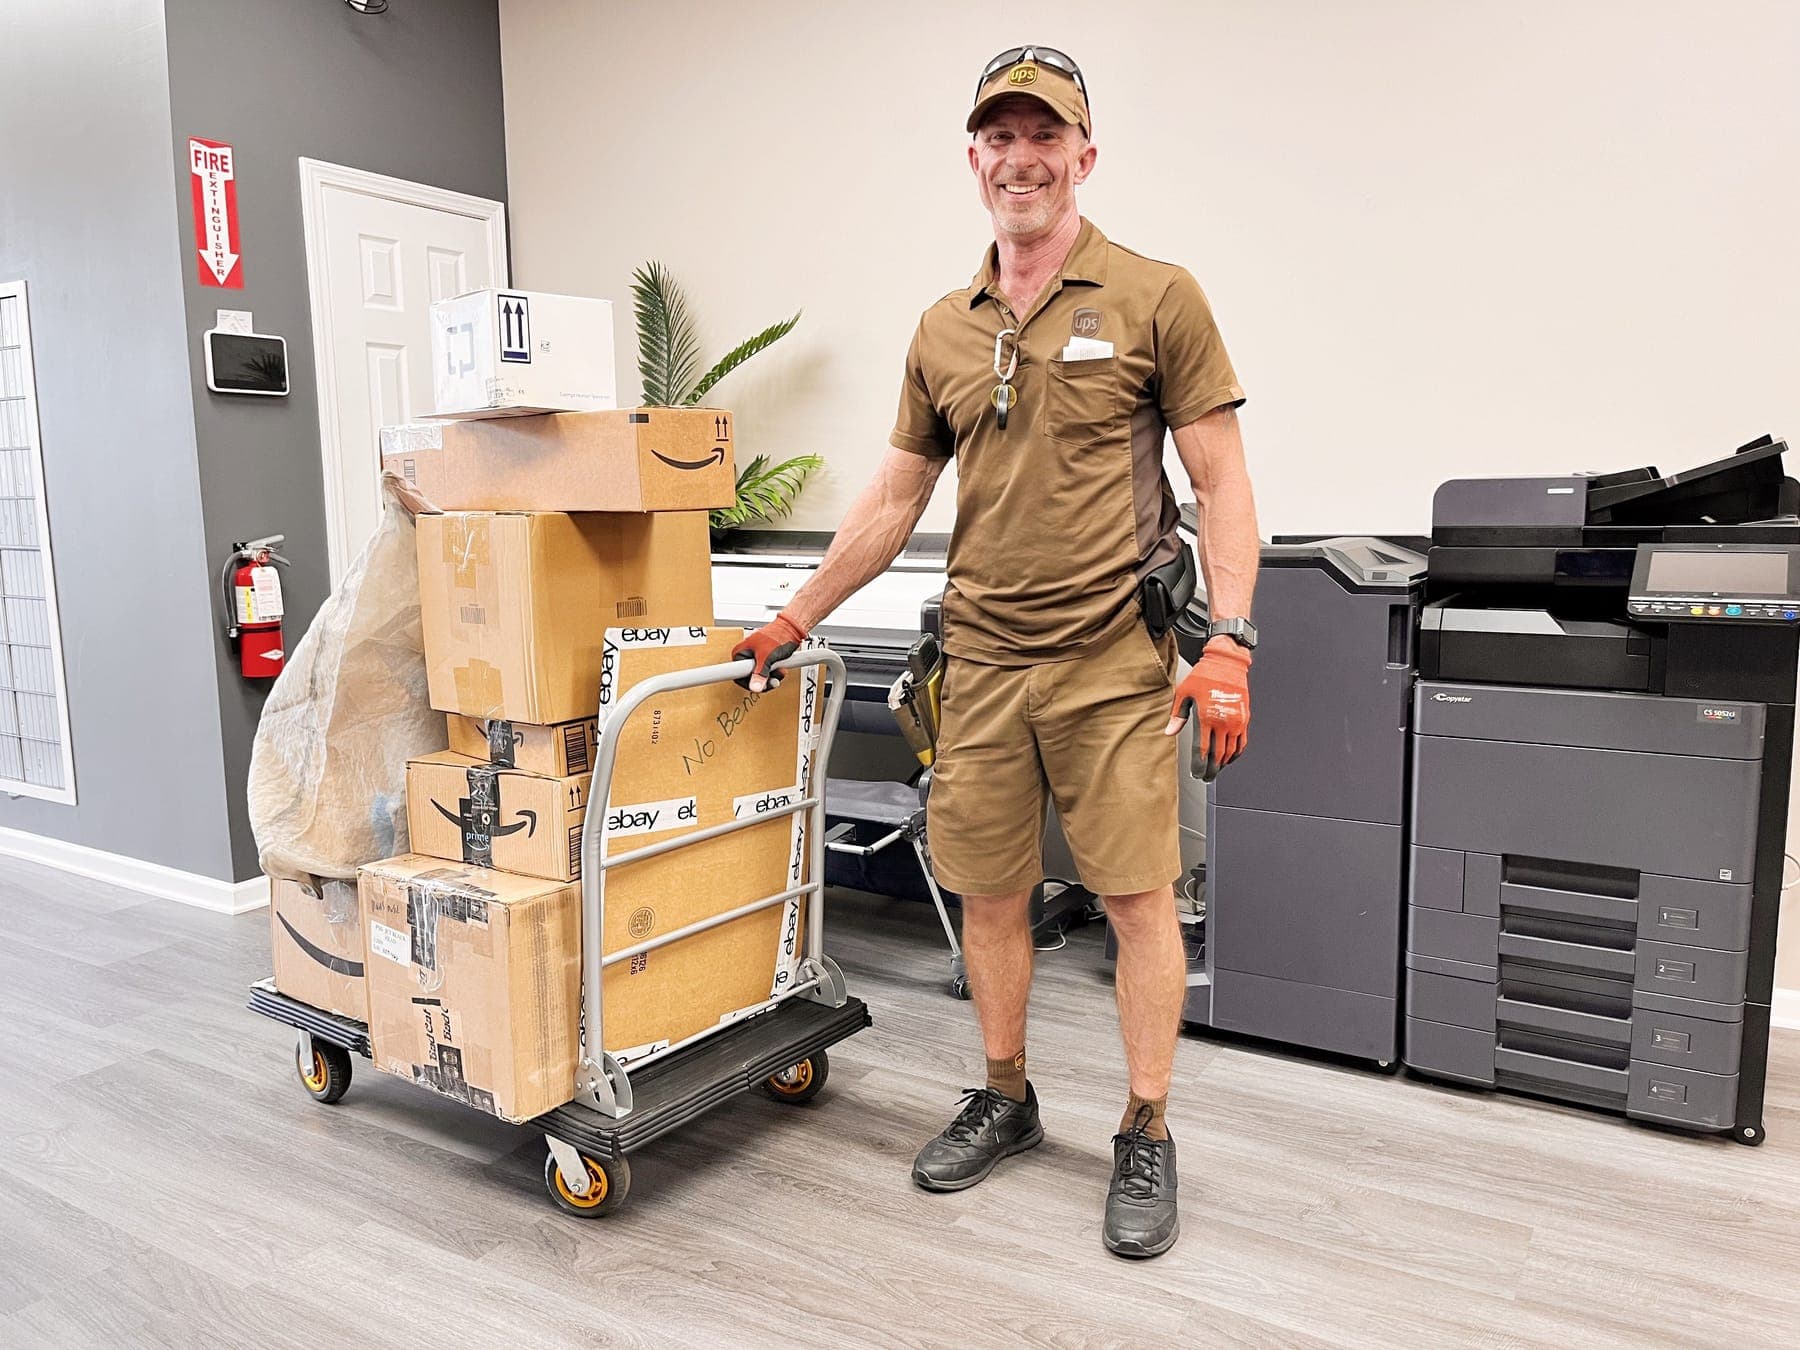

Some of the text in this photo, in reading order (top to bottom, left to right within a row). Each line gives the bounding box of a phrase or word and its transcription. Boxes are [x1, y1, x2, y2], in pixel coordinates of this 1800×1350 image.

[1010, 69, 1035, 82] ups
[194, 149, 230, 173] FIRE
[209, 171, 225, 276] EXTINGUISHER
[1074, 316, 1098, 335] ups
[600, 638, 619, 705] ebay
[682, 738, 715, 776] No
[608, 809, 660, 831] ebay
[466, 832, 489, 843] prime
[1662, 912, 1668, 920] 1
[783, 902, 799, 956] ebay
[1659, 964, 1665, 972] 2
[1655, 1034, 1661, 1042] 3
